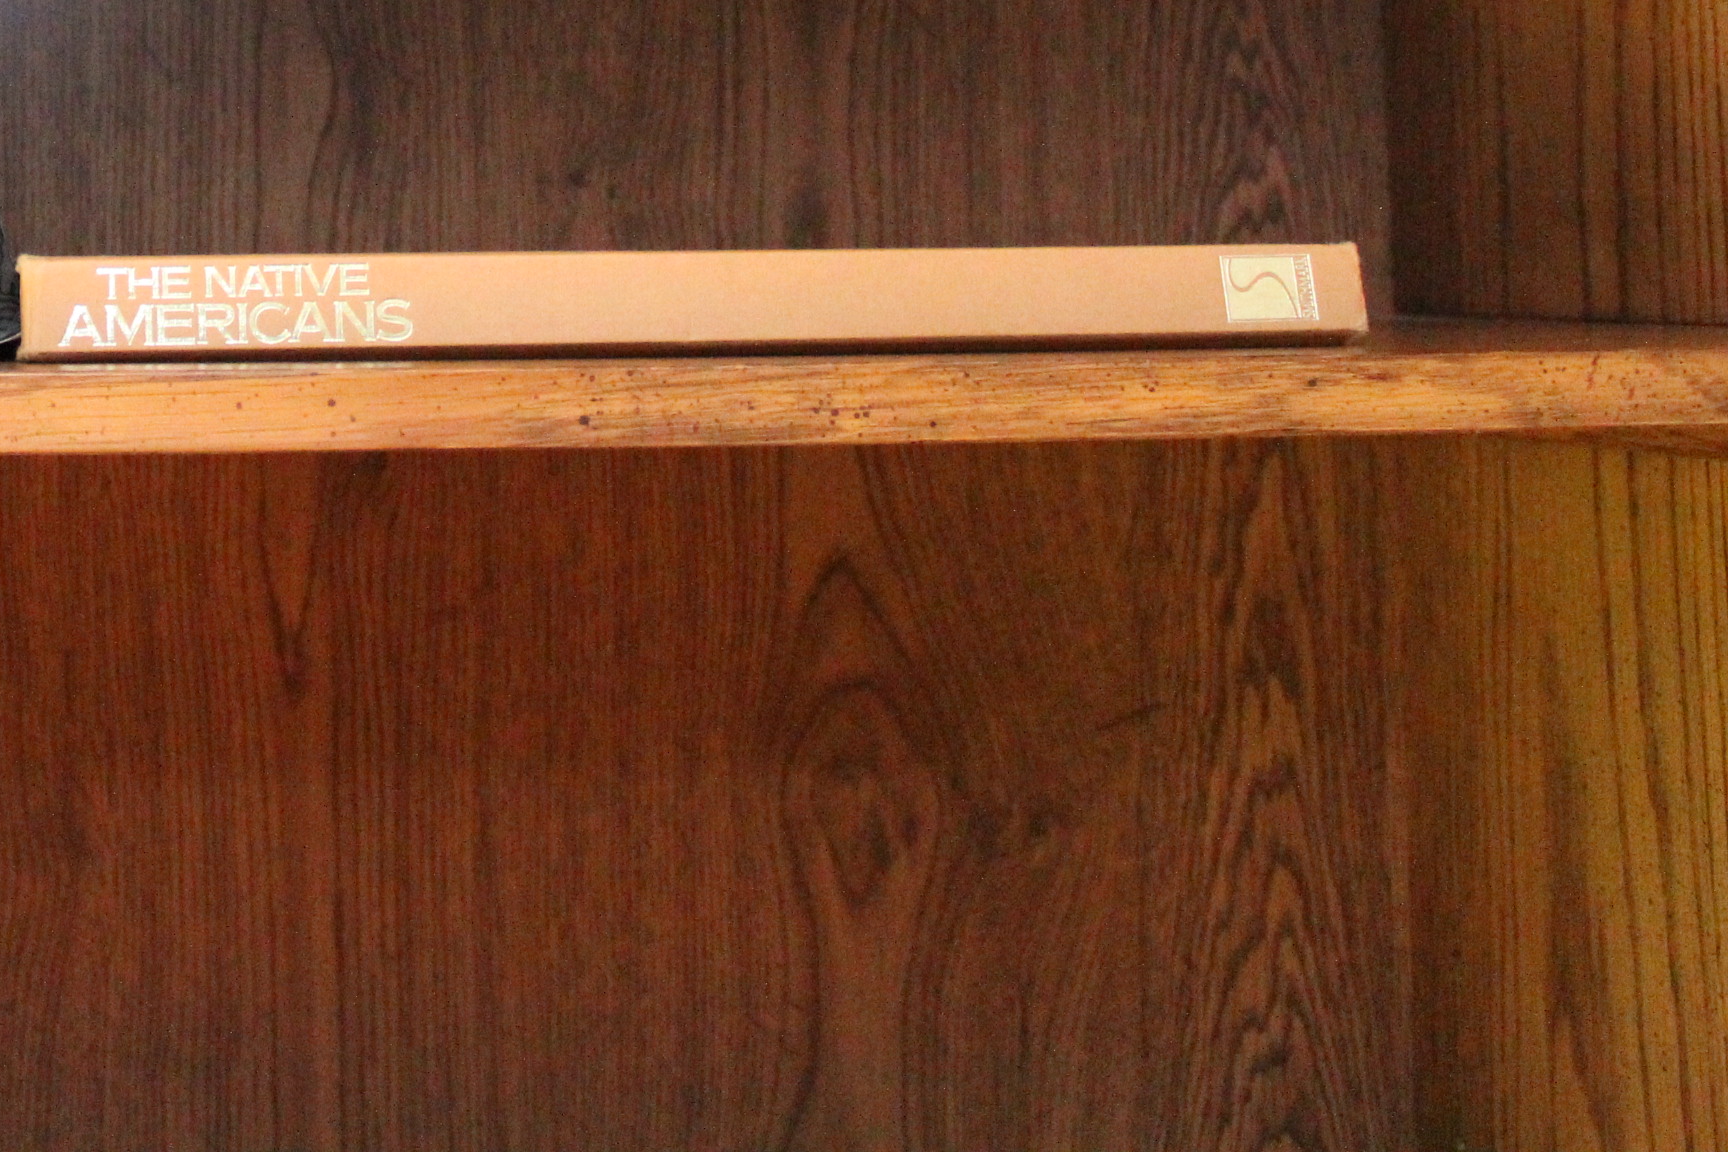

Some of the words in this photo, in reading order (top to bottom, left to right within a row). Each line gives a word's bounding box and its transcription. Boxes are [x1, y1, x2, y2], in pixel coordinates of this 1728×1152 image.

[95, 265, 193, 301] THE
[203, 261, 371, 298] NATIVE
[57, 298, 414, 348] AMERICANS
